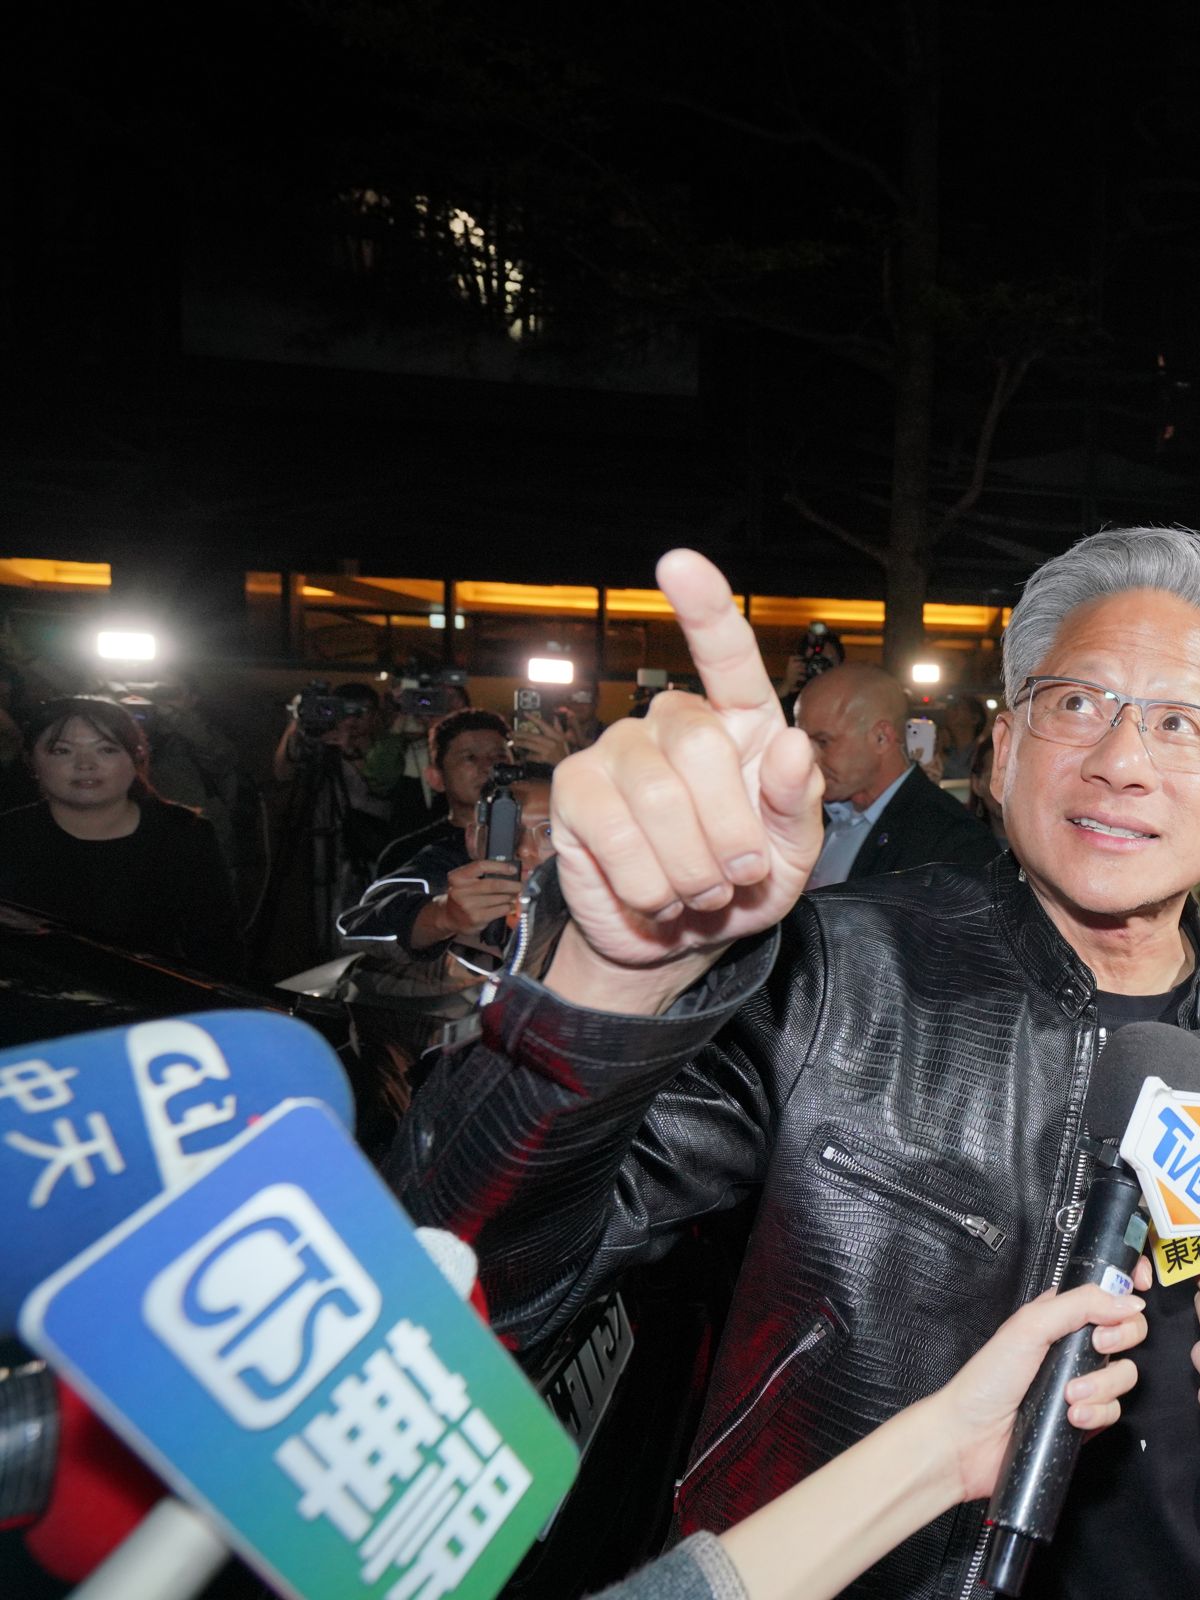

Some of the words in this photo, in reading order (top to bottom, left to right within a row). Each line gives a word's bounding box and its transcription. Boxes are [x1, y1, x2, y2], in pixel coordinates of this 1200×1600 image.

[0, 1059, 126, 1208] 中天
[182, 1216, 364, 1402] CTS
[273, 1319, 534, 1600] 華視
